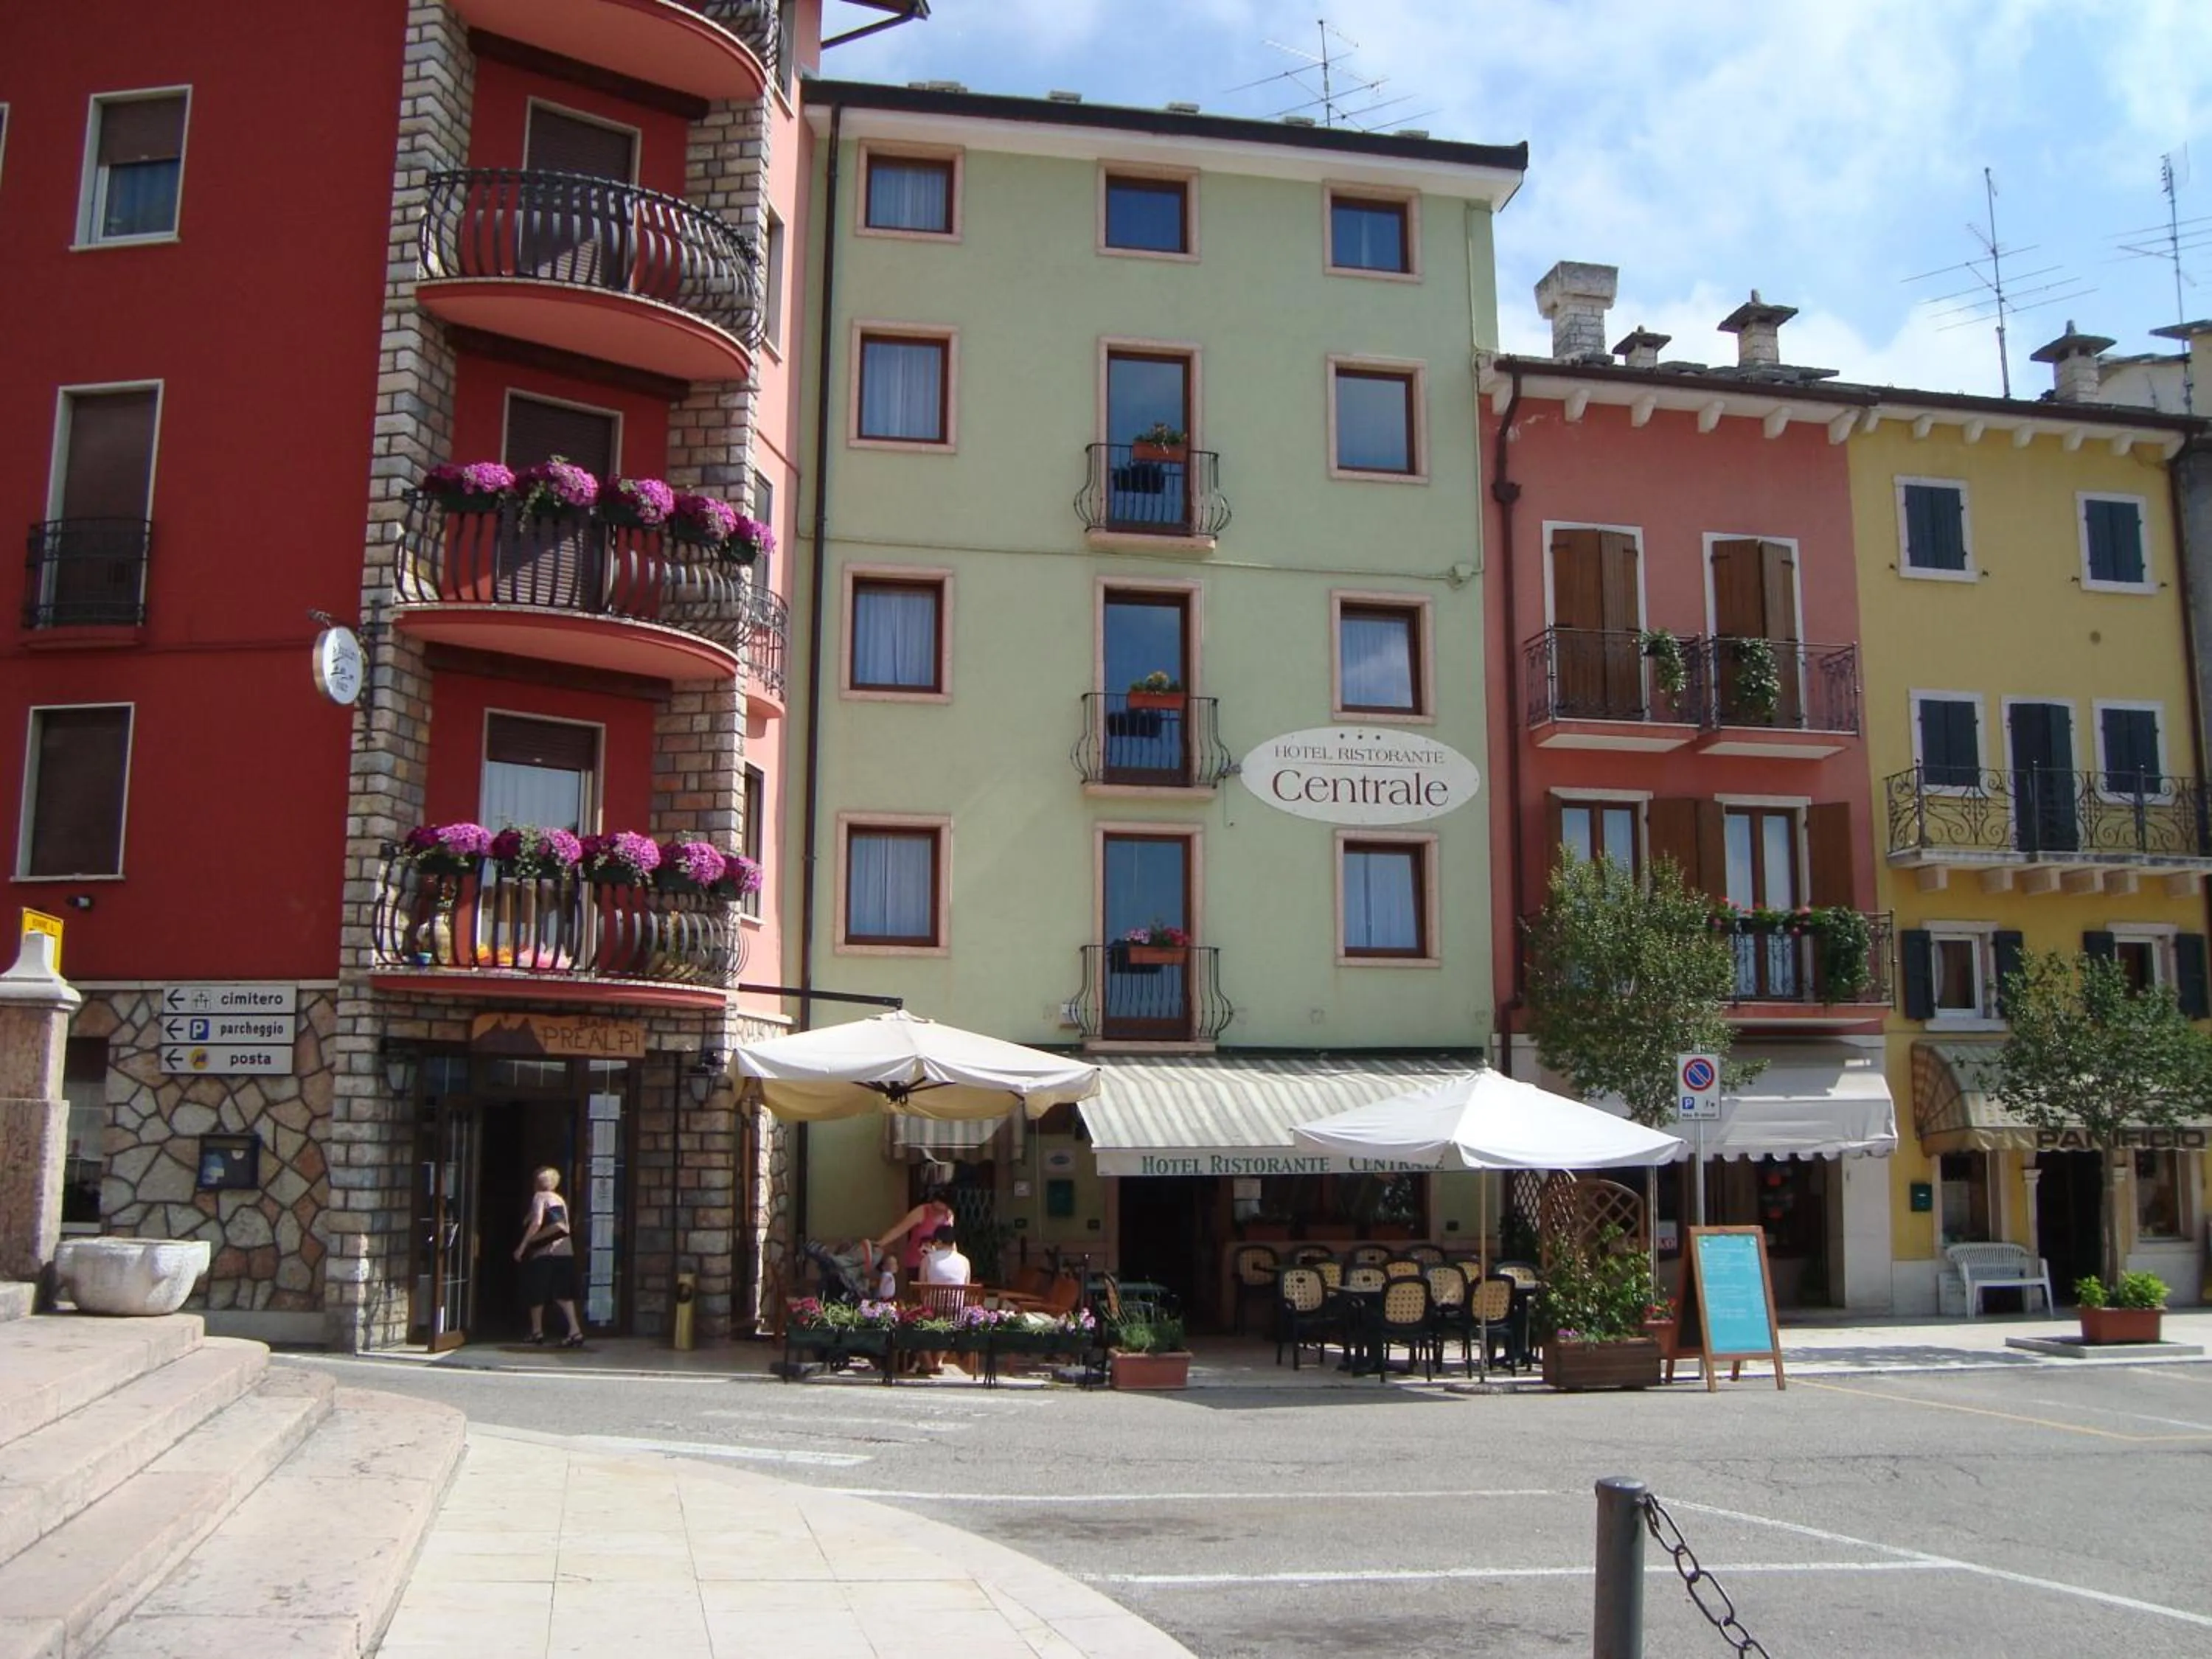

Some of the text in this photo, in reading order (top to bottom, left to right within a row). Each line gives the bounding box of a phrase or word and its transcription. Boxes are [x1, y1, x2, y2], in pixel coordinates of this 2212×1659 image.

[1275, 745, 1444, 764] HOTEL RISTORANTE
[1272, 769, 1449, 807] Centrale
[221, 992, 283, 1005] cimitero
[220, 1021, 284, 1037] parcheggio
[540, 1026, 639, 1052] PREALPI
[230, 1053, 271, 1066] posta
[1141, 1155, 1203, 1174] HOTEL
[1211, 1155, 1330, 1174] RISTORANTE
